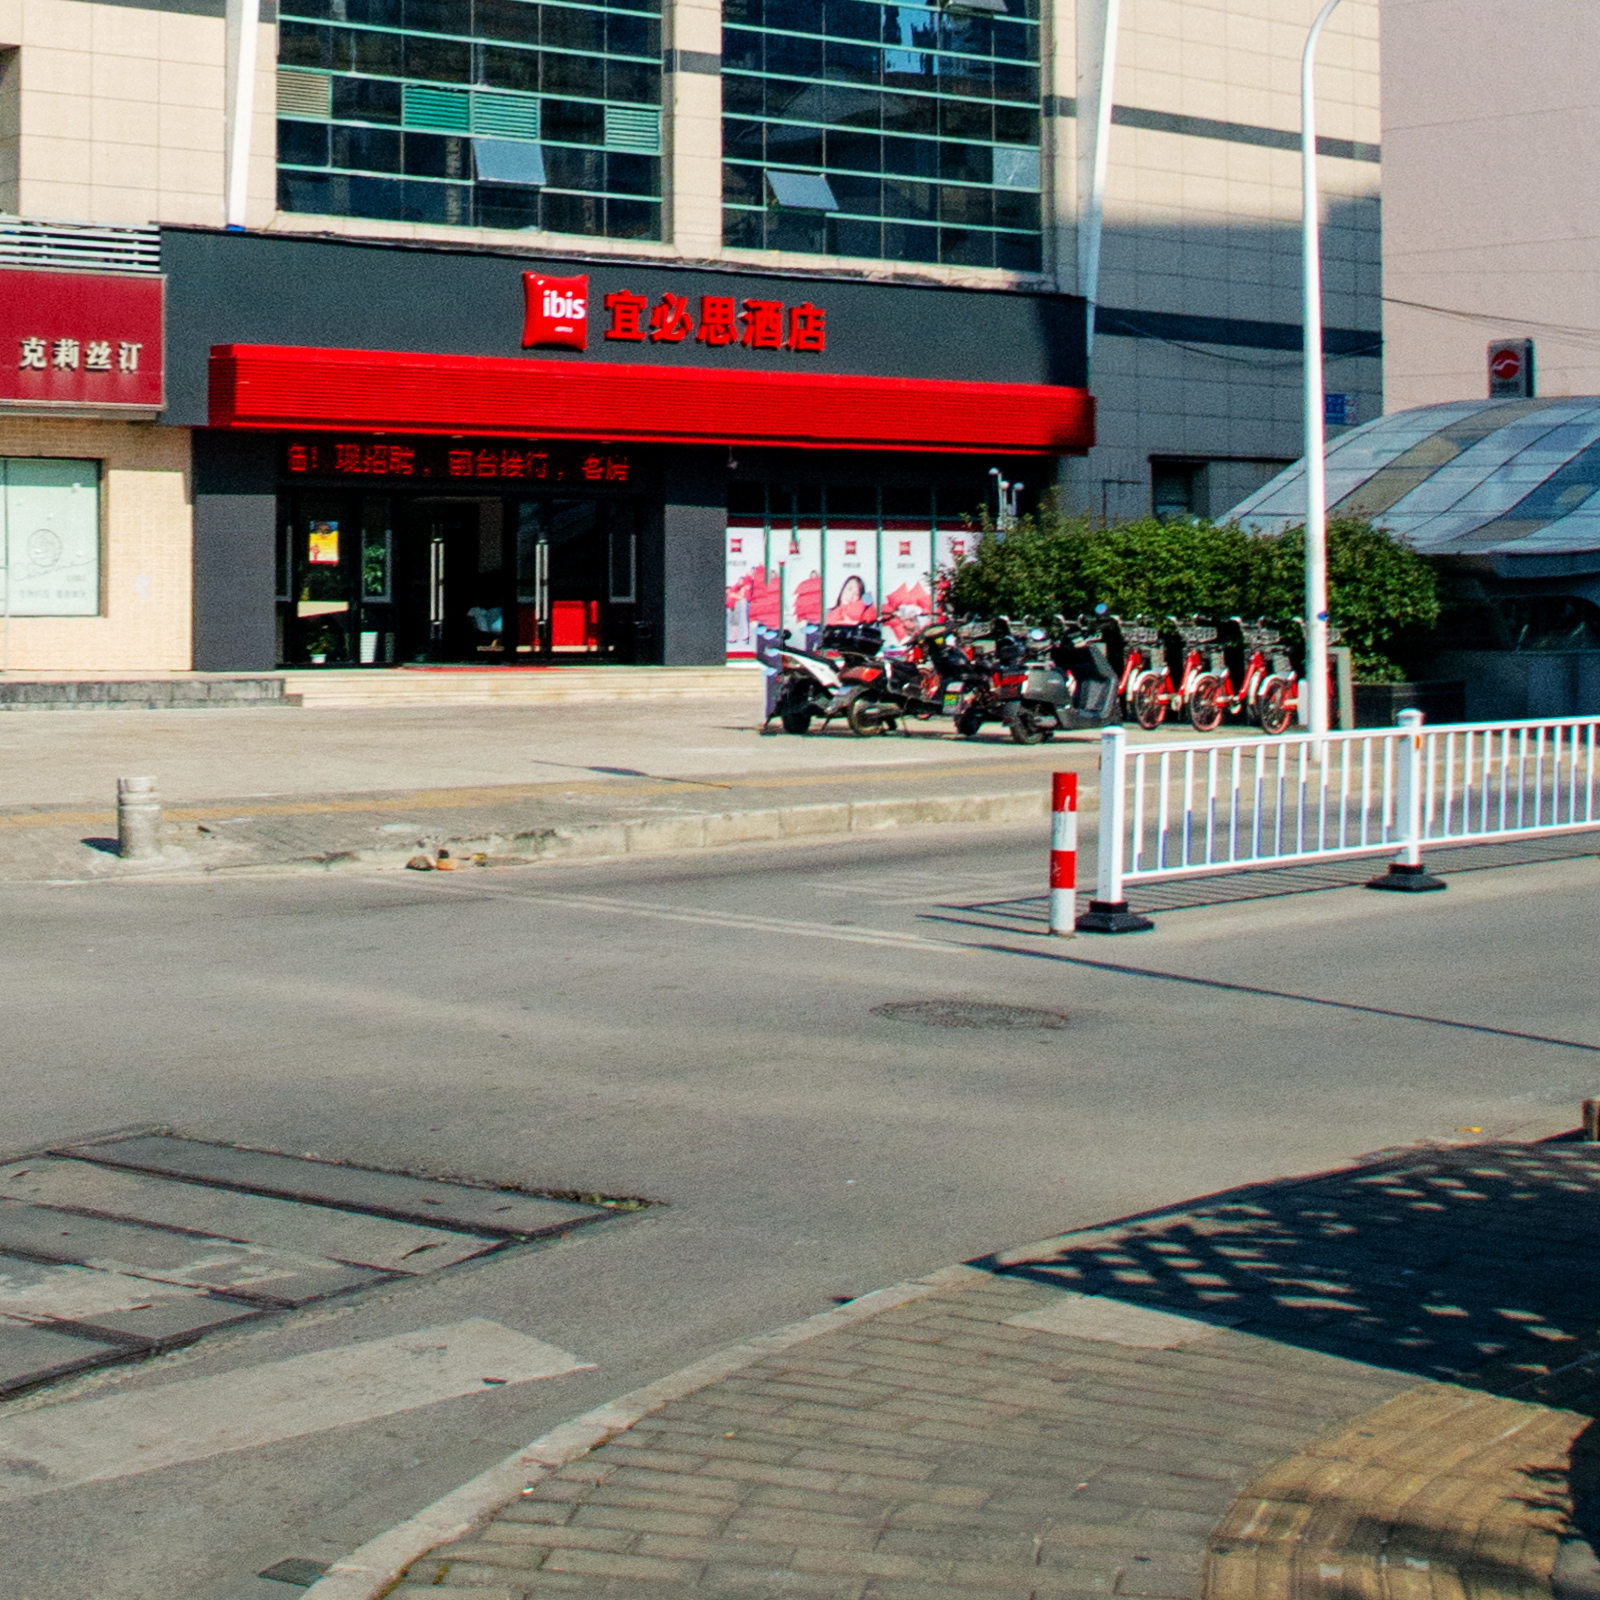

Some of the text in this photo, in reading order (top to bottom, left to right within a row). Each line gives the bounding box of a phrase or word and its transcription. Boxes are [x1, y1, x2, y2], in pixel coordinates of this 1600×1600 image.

[543, 290, 586, 319] ibis
[604, 289, 826, 352] 宜必思酒店
[19, 337, 142, 372] 克莉丝汀
